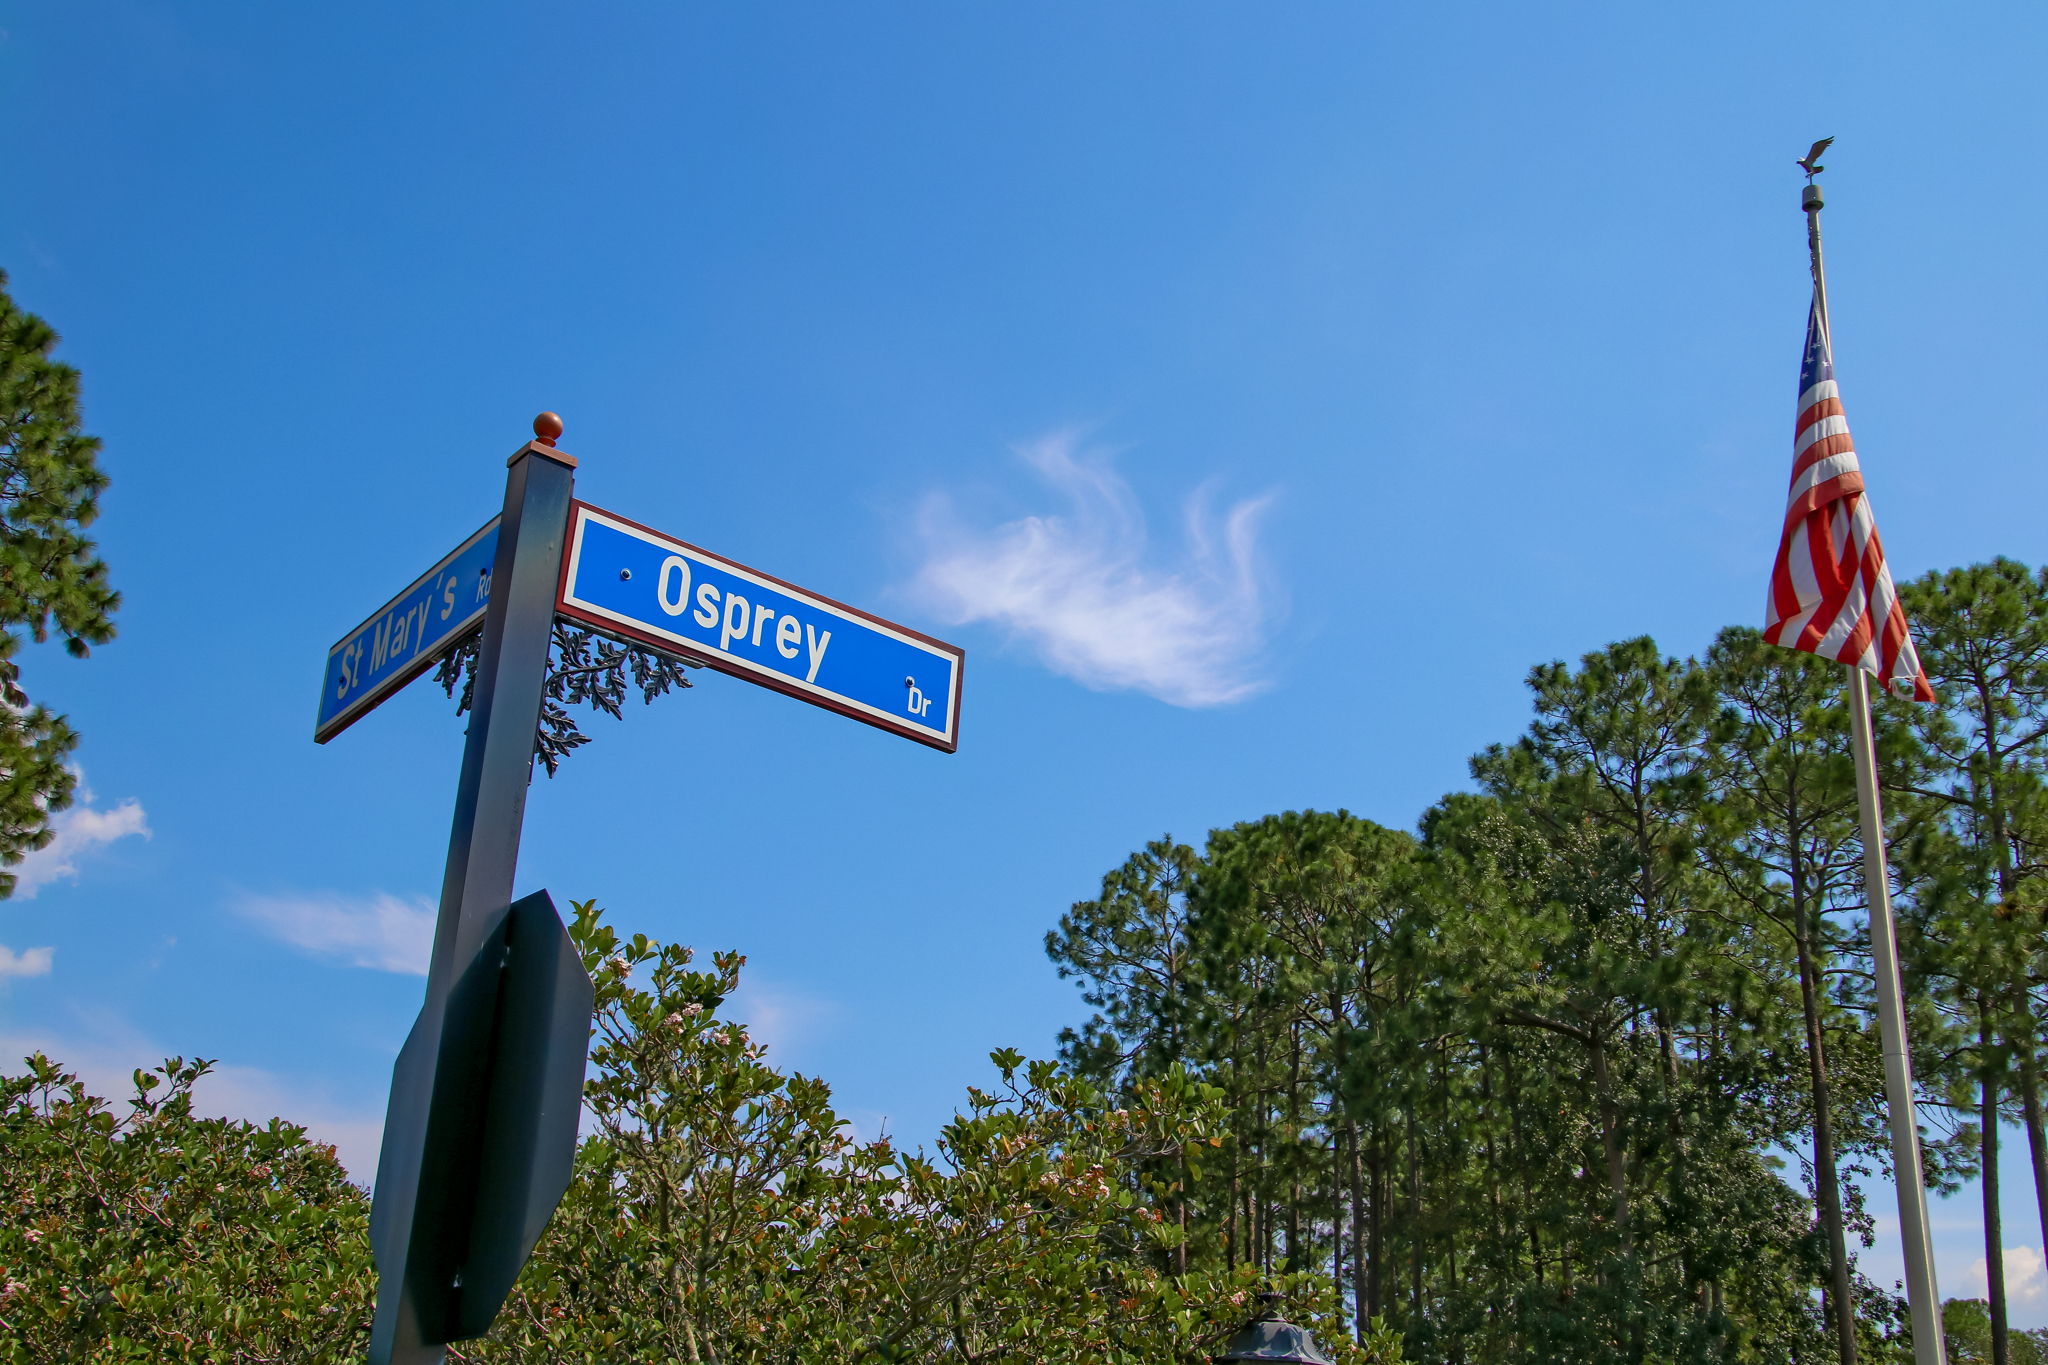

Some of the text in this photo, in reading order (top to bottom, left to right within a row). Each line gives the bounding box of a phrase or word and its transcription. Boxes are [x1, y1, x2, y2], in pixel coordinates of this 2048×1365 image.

[337, 568, 494, 700] St Mary's Rd
[657, 555, 932, 717] Osprey Dr
